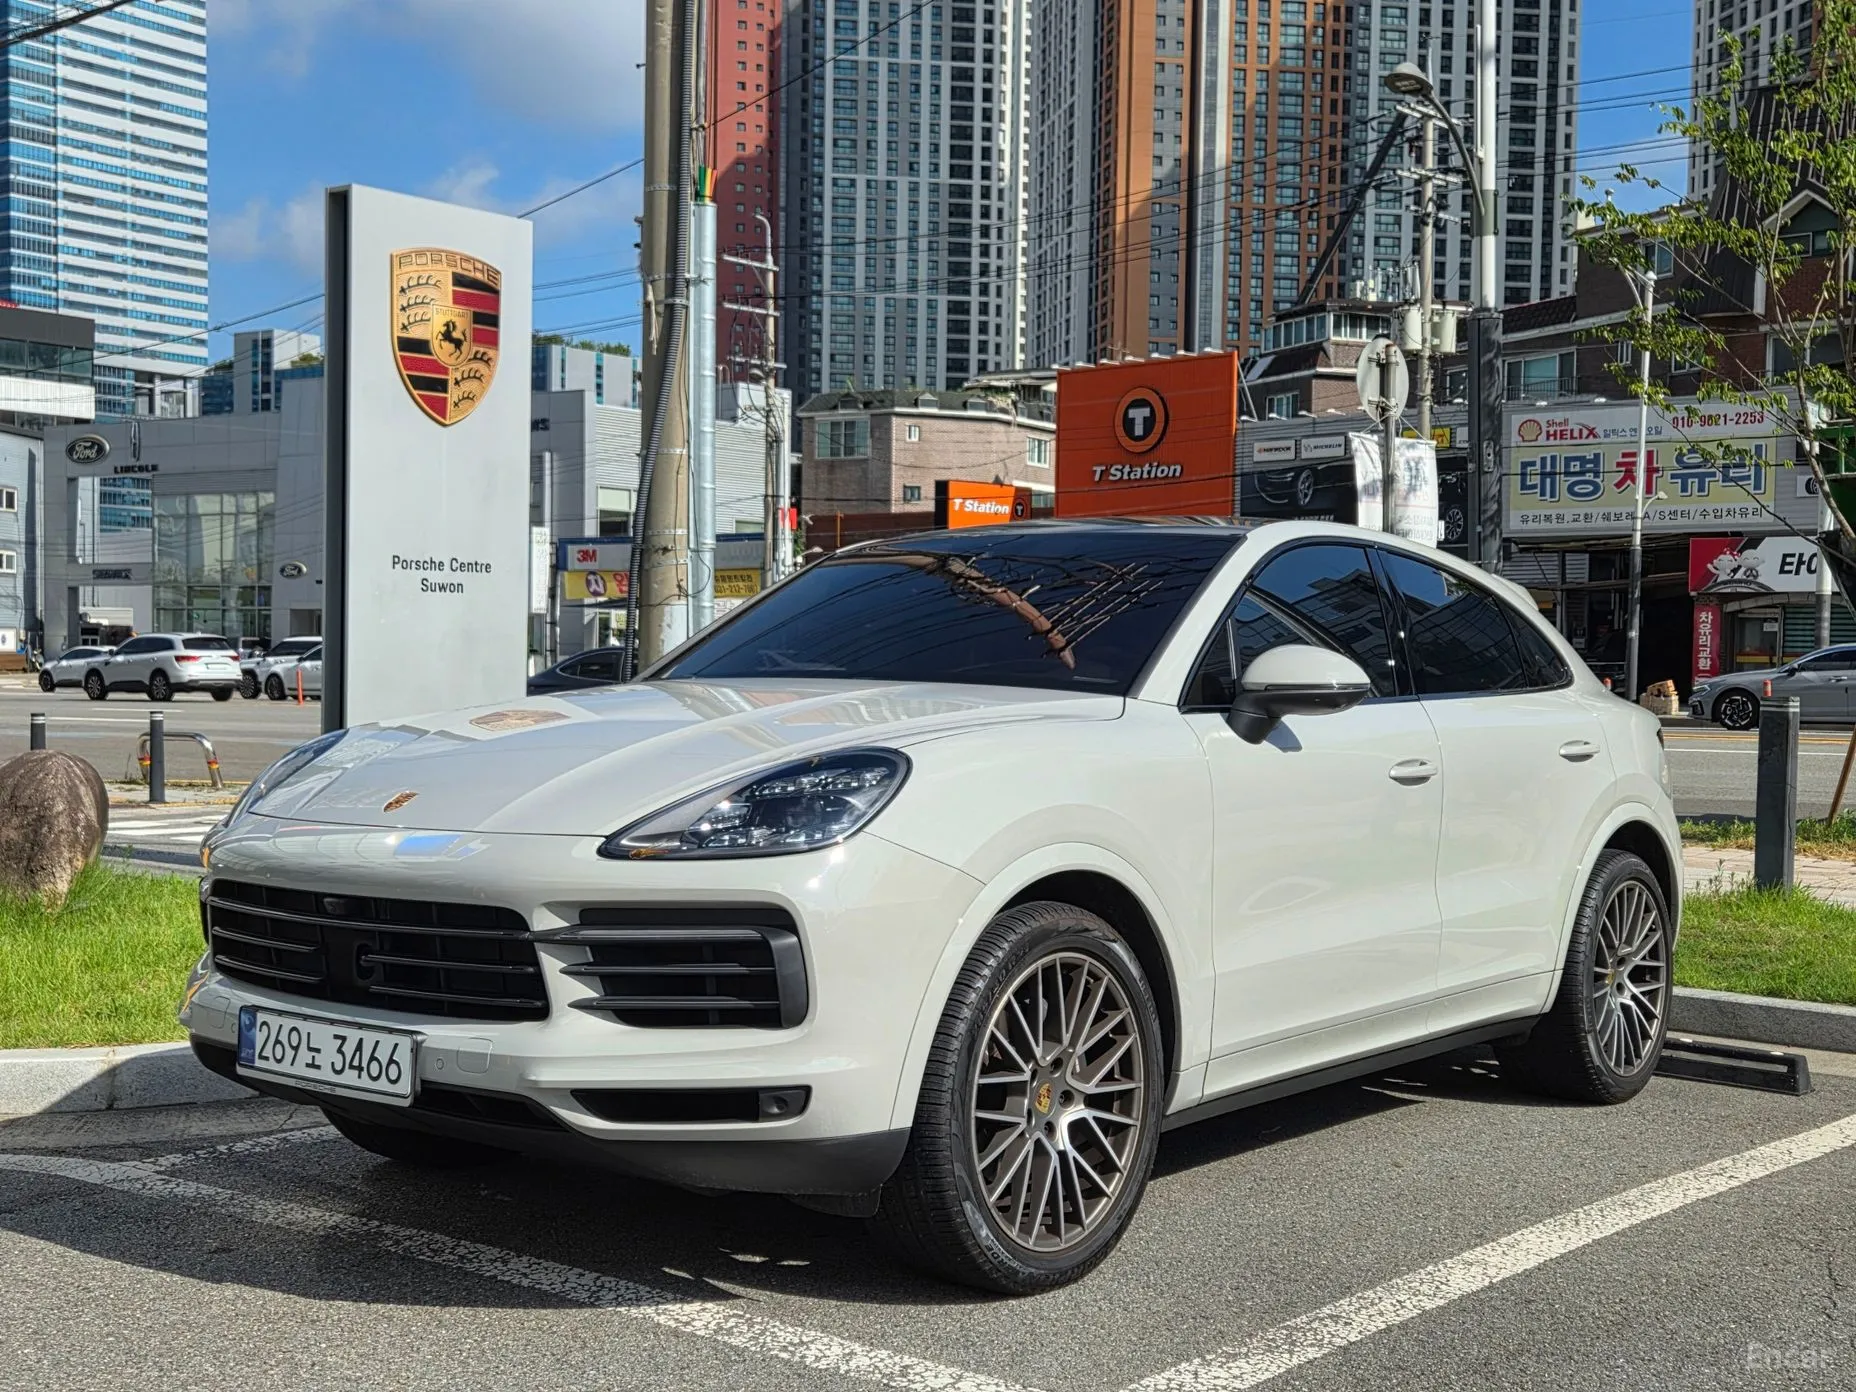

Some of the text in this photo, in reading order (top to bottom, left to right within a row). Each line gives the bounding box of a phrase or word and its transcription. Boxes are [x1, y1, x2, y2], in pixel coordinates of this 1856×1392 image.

[399, 252, 499, 286] PORSCHE
[1128, 407, 1151, 436] T
[1546, 418, 1569, 429] Shell
[1629, 425, 1663, 437] 엔오일
[1546, 426, 1600, 441] HELIX
[73, 441, 98, 460] Ford
[1092, 462, 1182, 482] T Station
[1520, 451, 1604, 501] 대명
[953, 498, 1010, 514] T Station
[392, 554, 492, 573] Porsche Centre
[576, 549, 598, 563] 3M
[421, 577, 464, 593] Suwon
[257, 1021, 402, 1085] 269노 3466
